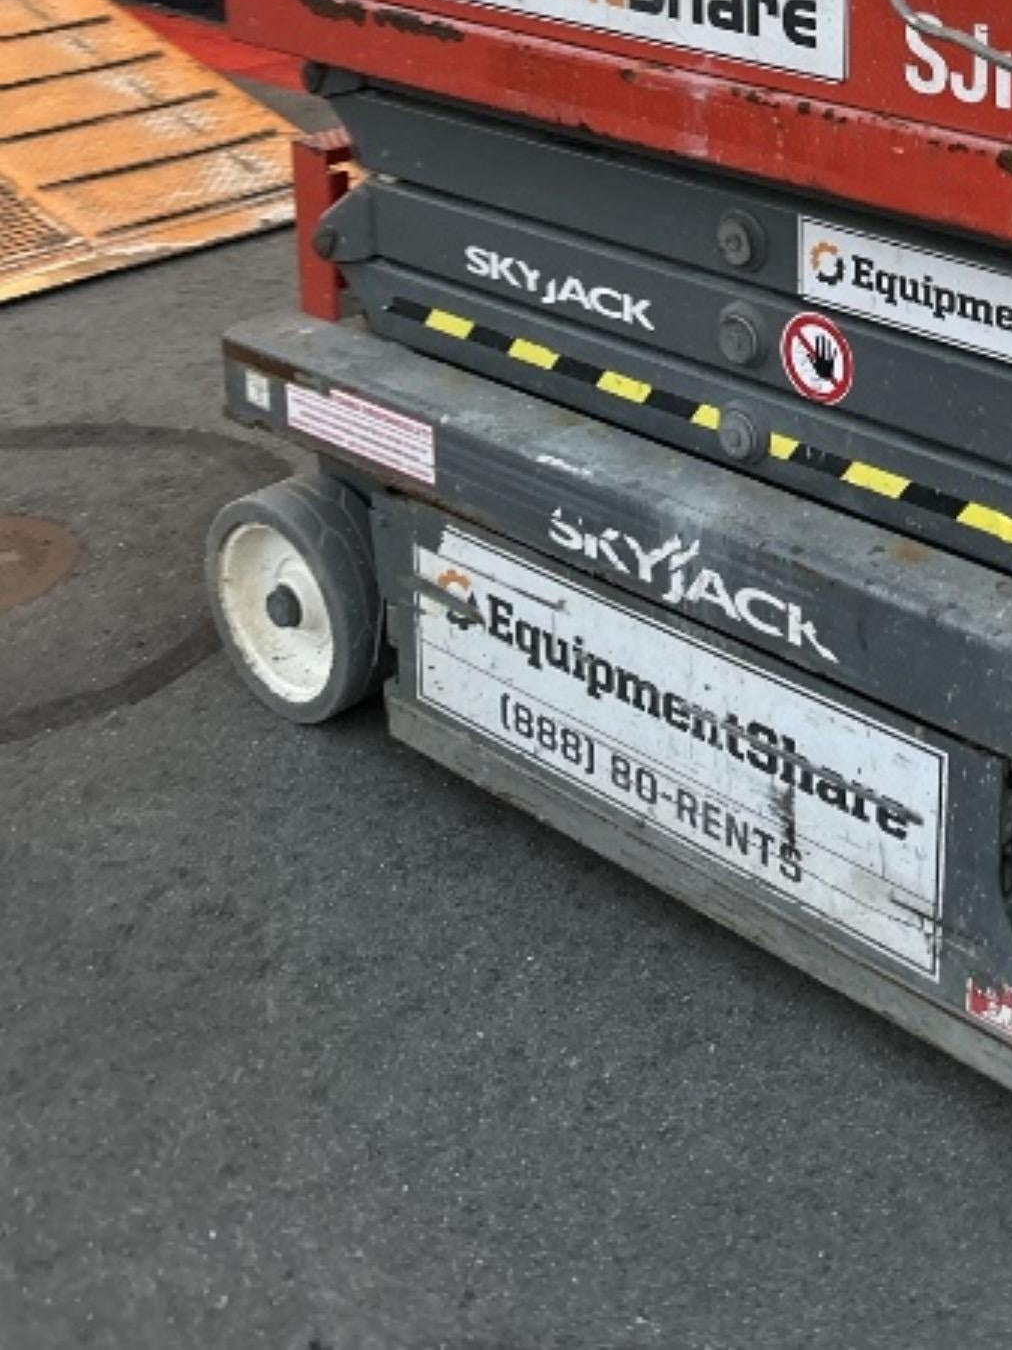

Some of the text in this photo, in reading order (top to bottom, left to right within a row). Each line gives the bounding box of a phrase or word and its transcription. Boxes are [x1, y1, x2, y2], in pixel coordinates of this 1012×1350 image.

[464, 245, 656, 332] SKYJACK
[548, 507, 840, 664] SKYJACK
[486, 593, 916, 840] EquipmentShare
[500, 692, 803, 884] (888) 80-RENTS
